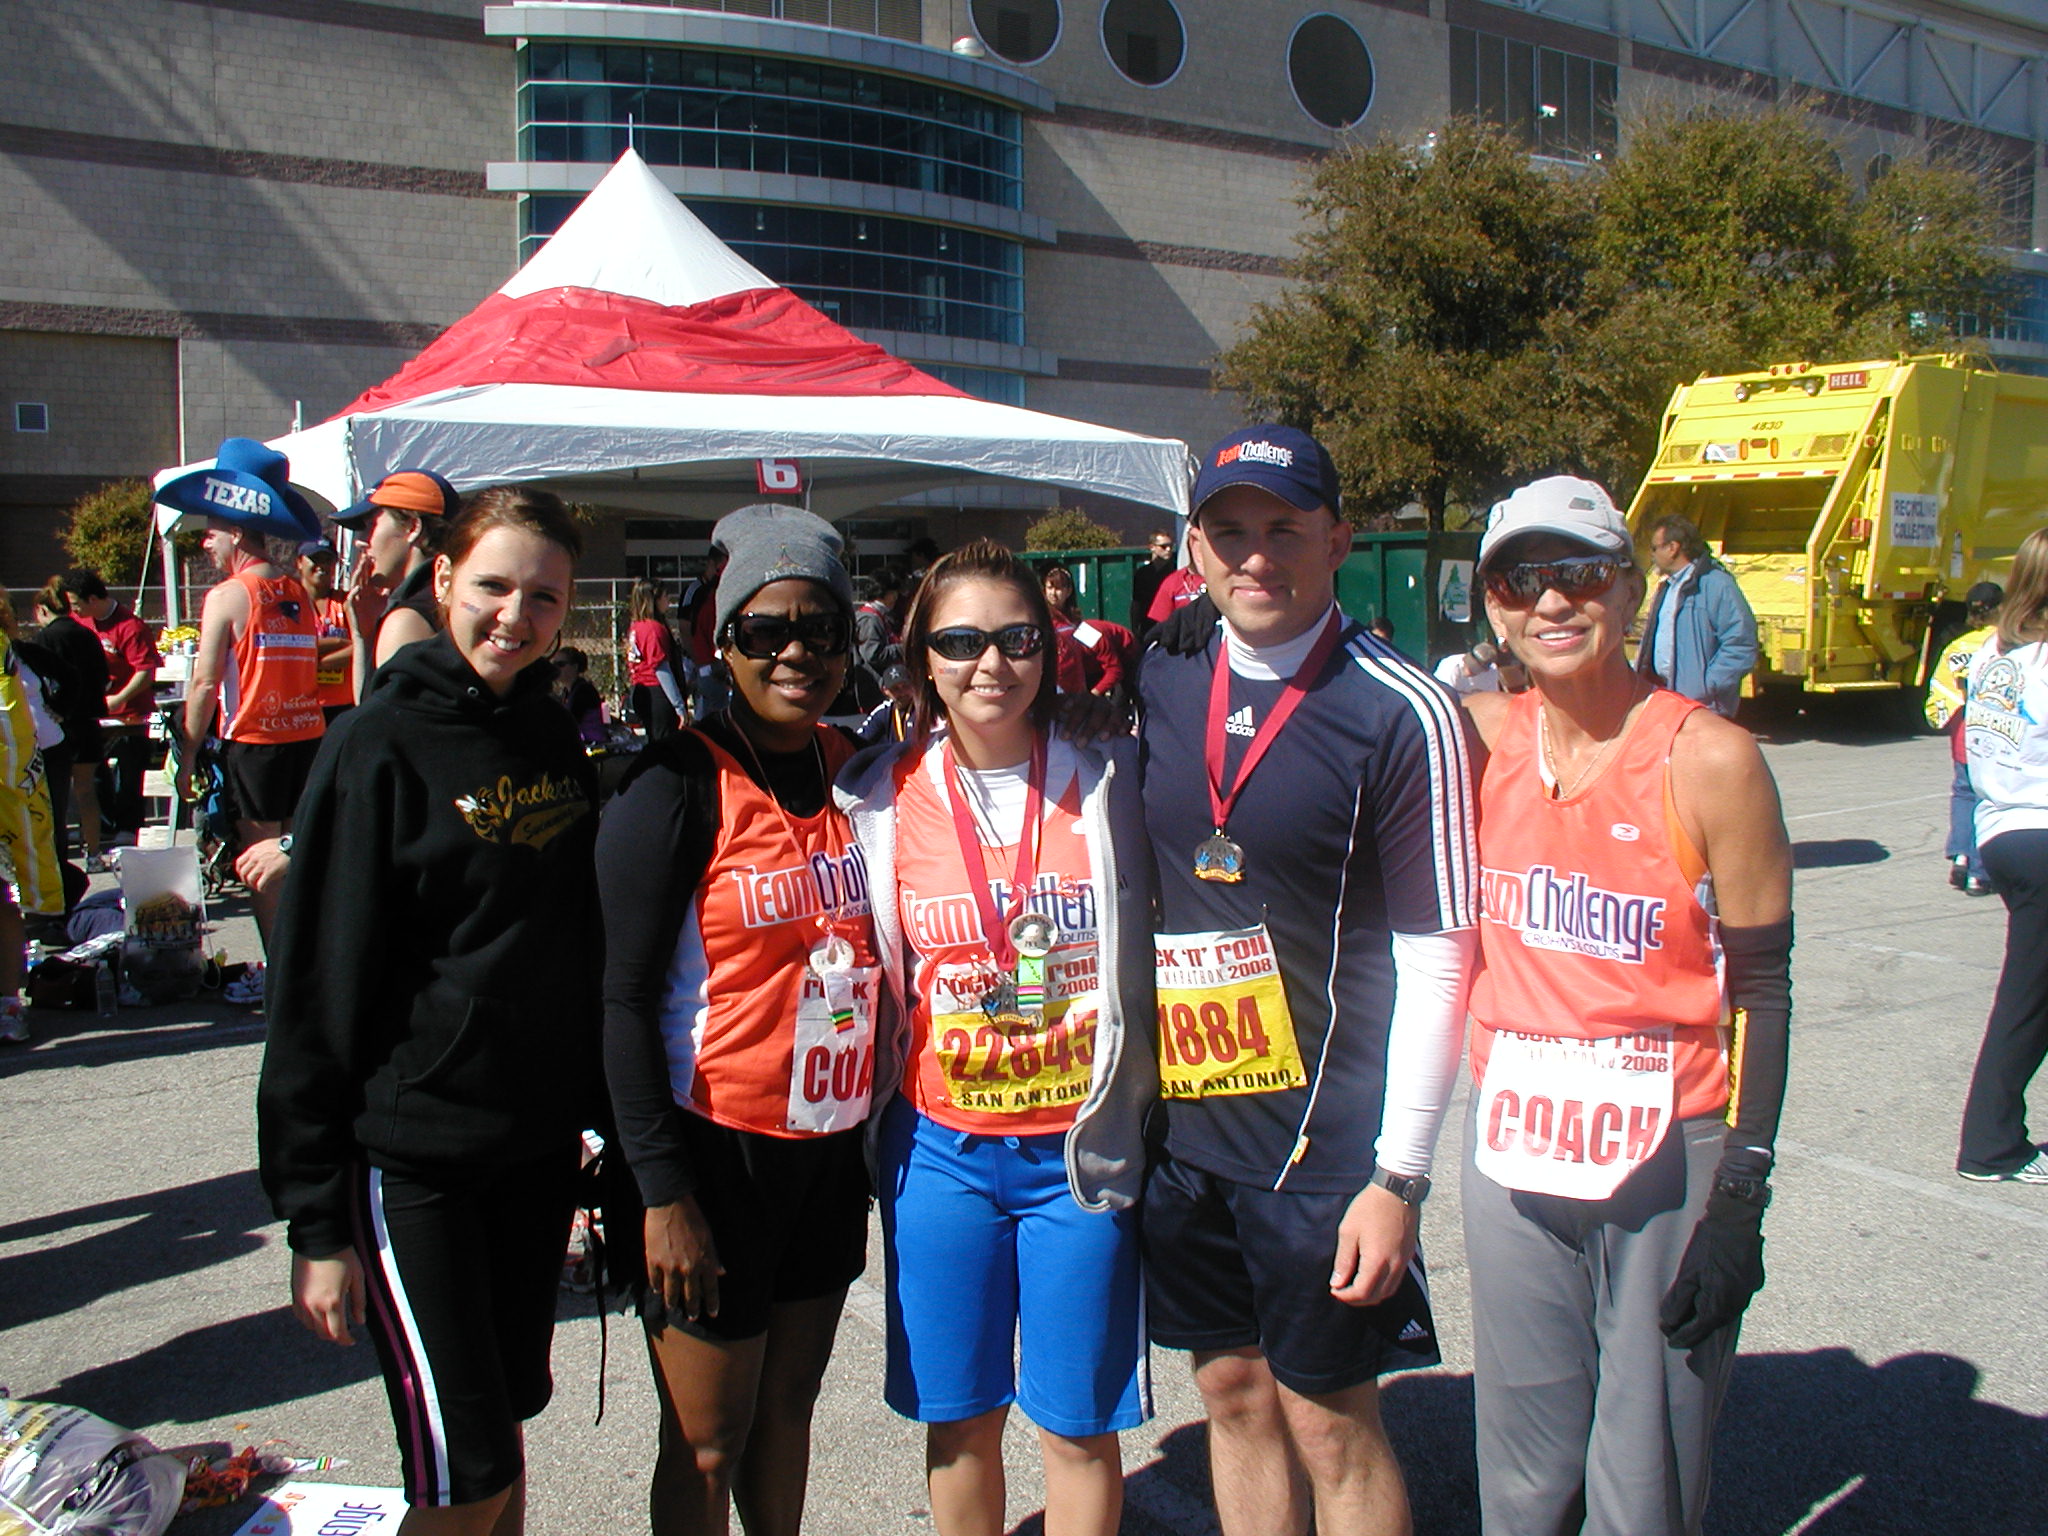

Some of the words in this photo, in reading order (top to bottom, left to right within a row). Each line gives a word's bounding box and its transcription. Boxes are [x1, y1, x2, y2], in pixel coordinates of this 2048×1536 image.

[1831, 373, 1862, 387] HEIL
[1751, 420, 1783, 431] 4830
[762, 459, 798, 489] 6
[203, 477, 271, 516] TEXAS
[1894, 500, 1937, 518] RECYCLING
[1894, 523, 1937, 541] COLLECTION
[1225, 722, 1256, 737] adidas
[1227, 958, 1273, 980] 2008
[1057, 977, 1099, 997] 2008
[942, 1009, 1099, 1082] 22845
[1621, 1054, 1668, 1073] 2008
[1161, 1079, 1194, 1094] SAN
[962, 1091, 1003, 1108] SAN
[1487, 1089, 1661, 1166] COACH
